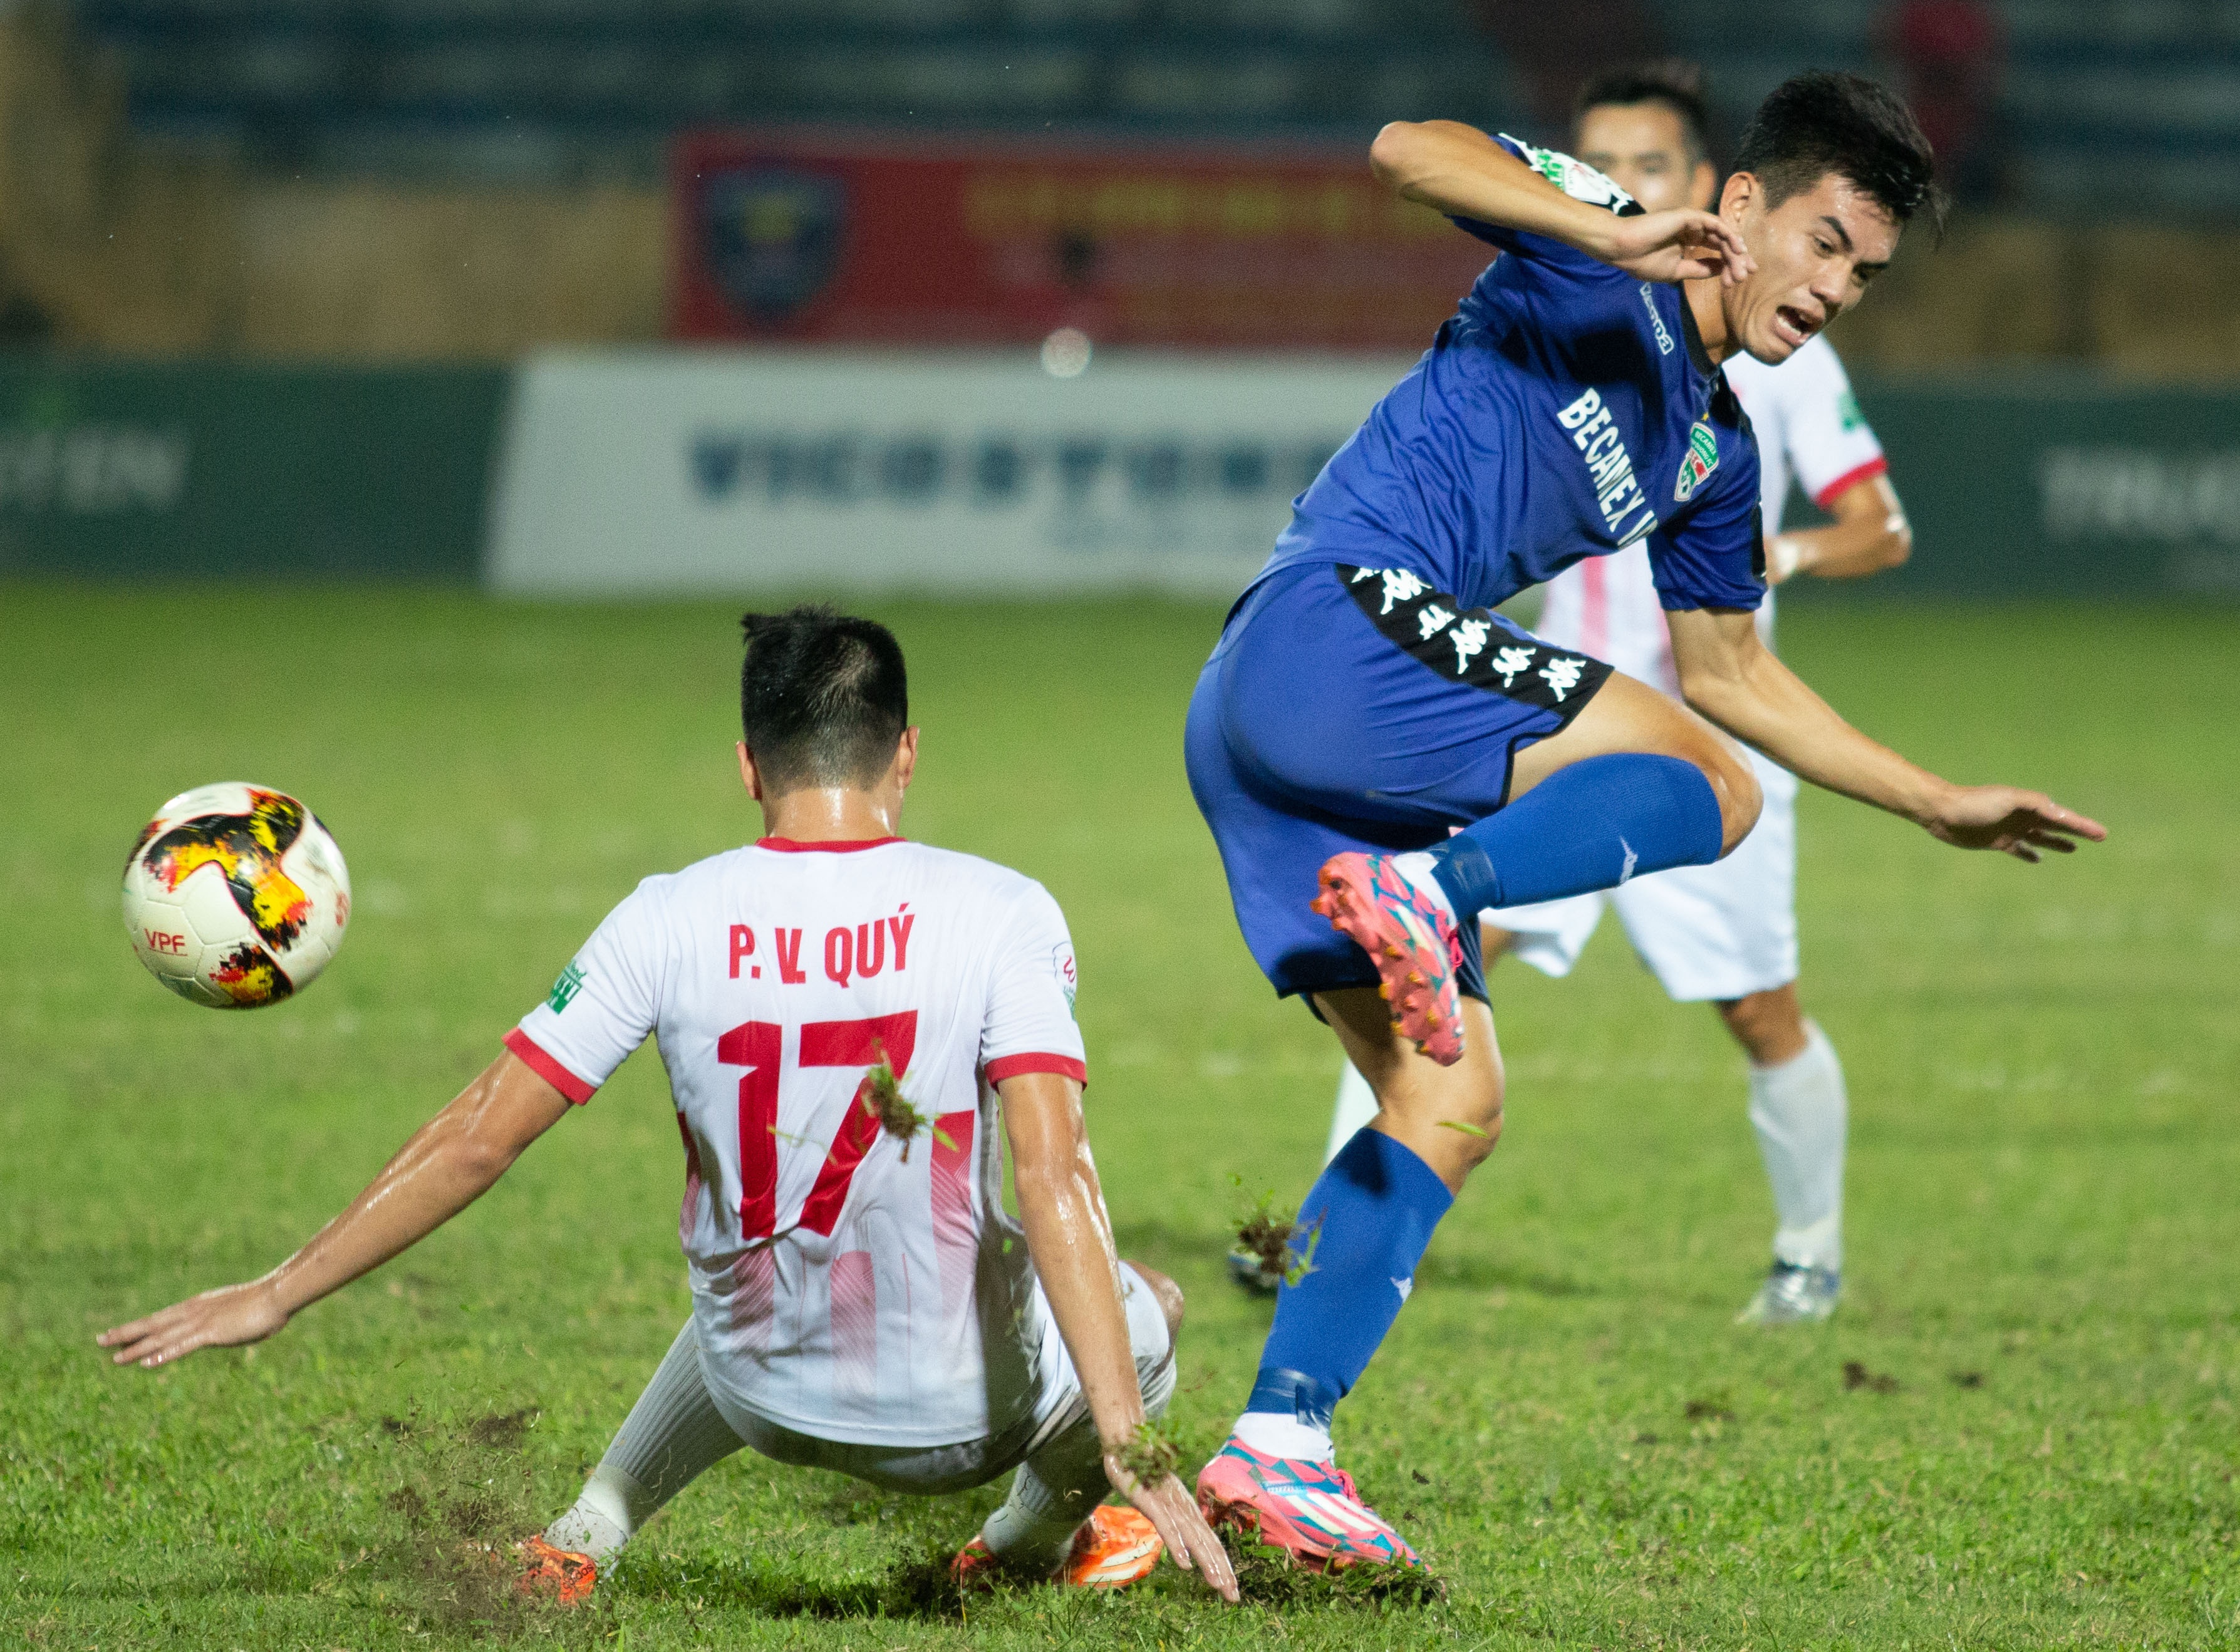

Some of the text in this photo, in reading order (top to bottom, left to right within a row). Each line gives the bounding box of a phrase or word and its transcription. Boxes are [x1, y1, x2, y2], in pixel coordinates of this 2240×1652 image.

[143, 928, 185, 952] VPF
[729, 902, 915, 989] P. V. QUÝ
[717, 1009, 918, 1241] 17
